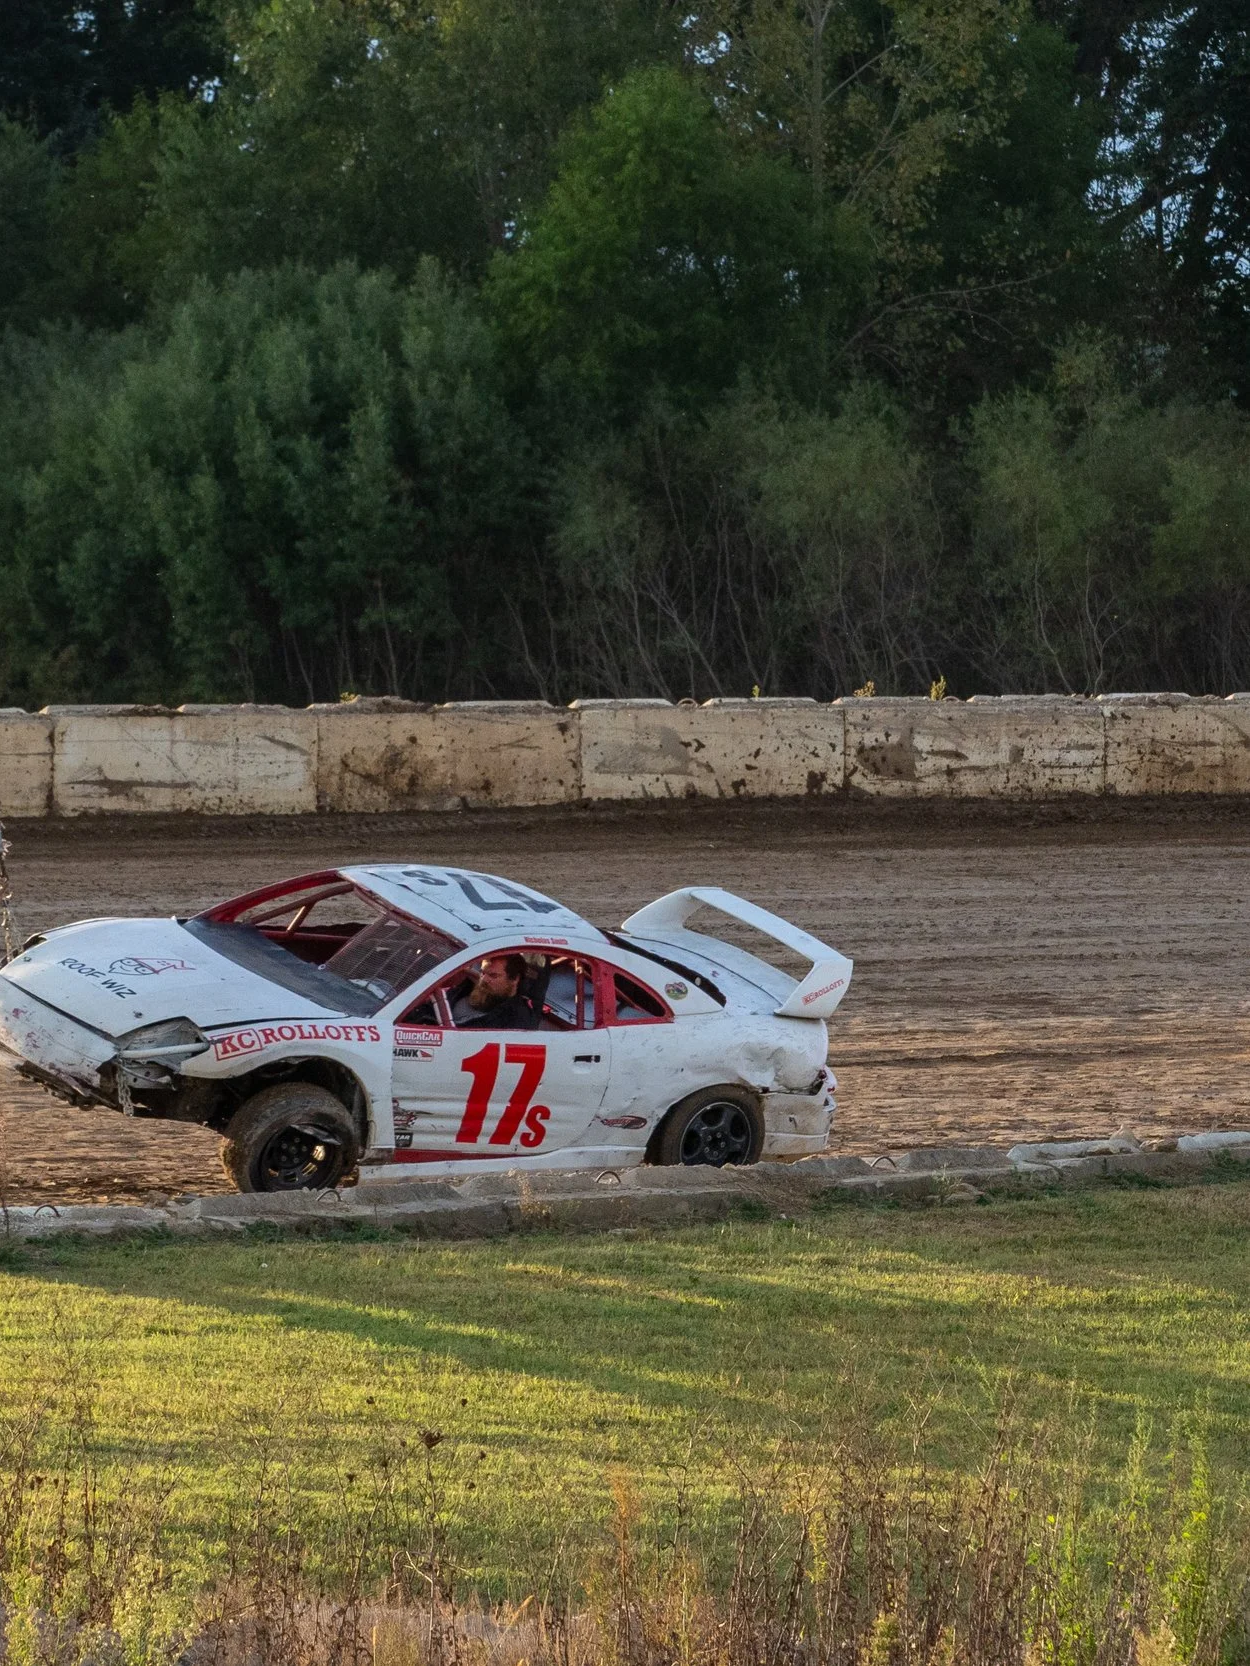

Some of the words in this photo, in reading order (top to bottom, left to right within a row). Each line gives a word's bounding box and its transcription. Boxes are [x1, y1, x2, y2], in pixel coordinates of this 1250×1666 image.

[57, 958, 106, 978] ROOF
[101, 979, 137, 999] WIZ
[221, 1031, 256, 1055] KC
[260, 1024, 381, 1045] ROLLOFFS
